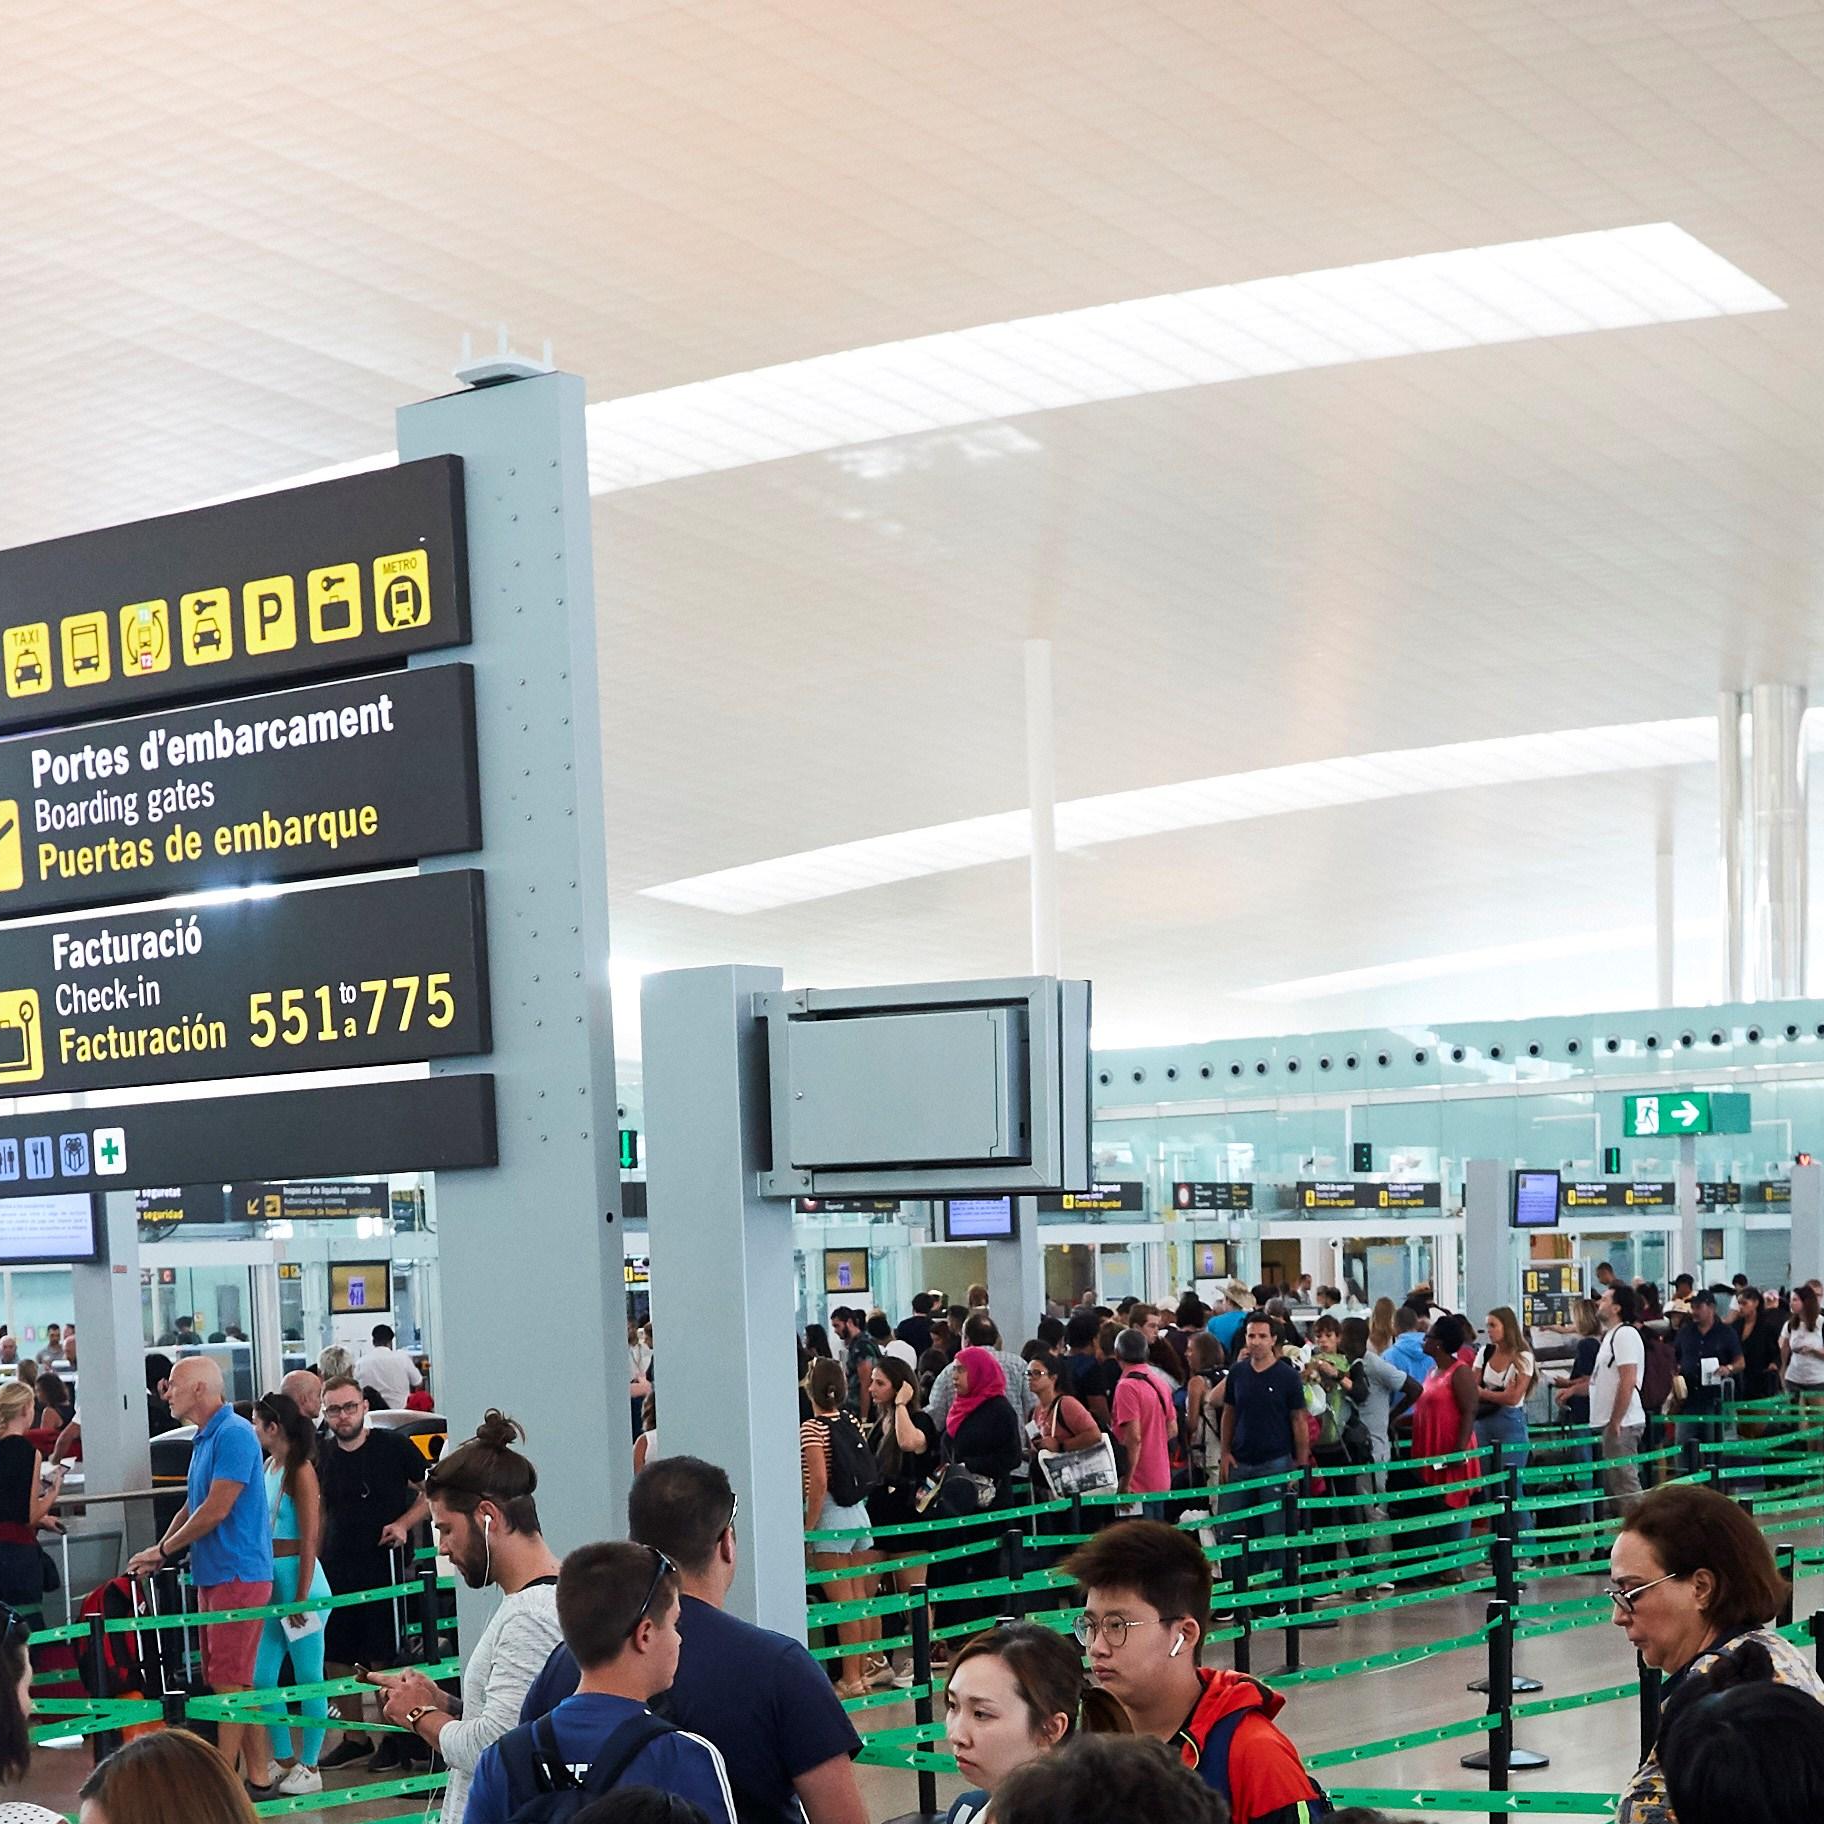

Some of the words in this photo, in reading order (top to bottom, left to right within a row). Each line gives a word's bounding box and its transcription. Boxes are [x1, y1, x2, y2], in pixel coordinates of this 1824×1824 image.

[383, 557, 418, 574] METRO
[12, 629, 40, 646] TAXI
[32, 743, 129, 789] Portes
[140, 694, 394, 772] d'embarcament
[34, 788, 138, 834] Boarding
[147, 778, 216, 823] gates
[38, 835, 154, 881] Puertas
[164, 824, 203, 864] de
[214, 804, 379, 857] embarque
[52, 914, 202, 971] Facturació
[54, 973, 161, 1016] Check-in
[249, 985, 339, 1049] 551
[339, 981, 357, 1005] to
[360, 972, 456, 1036] 775
[59, 1012, 227, 1065] Facturación
[343, 1016, 358, 1039] a
[142, 1209, 184, 1220] seguridad
